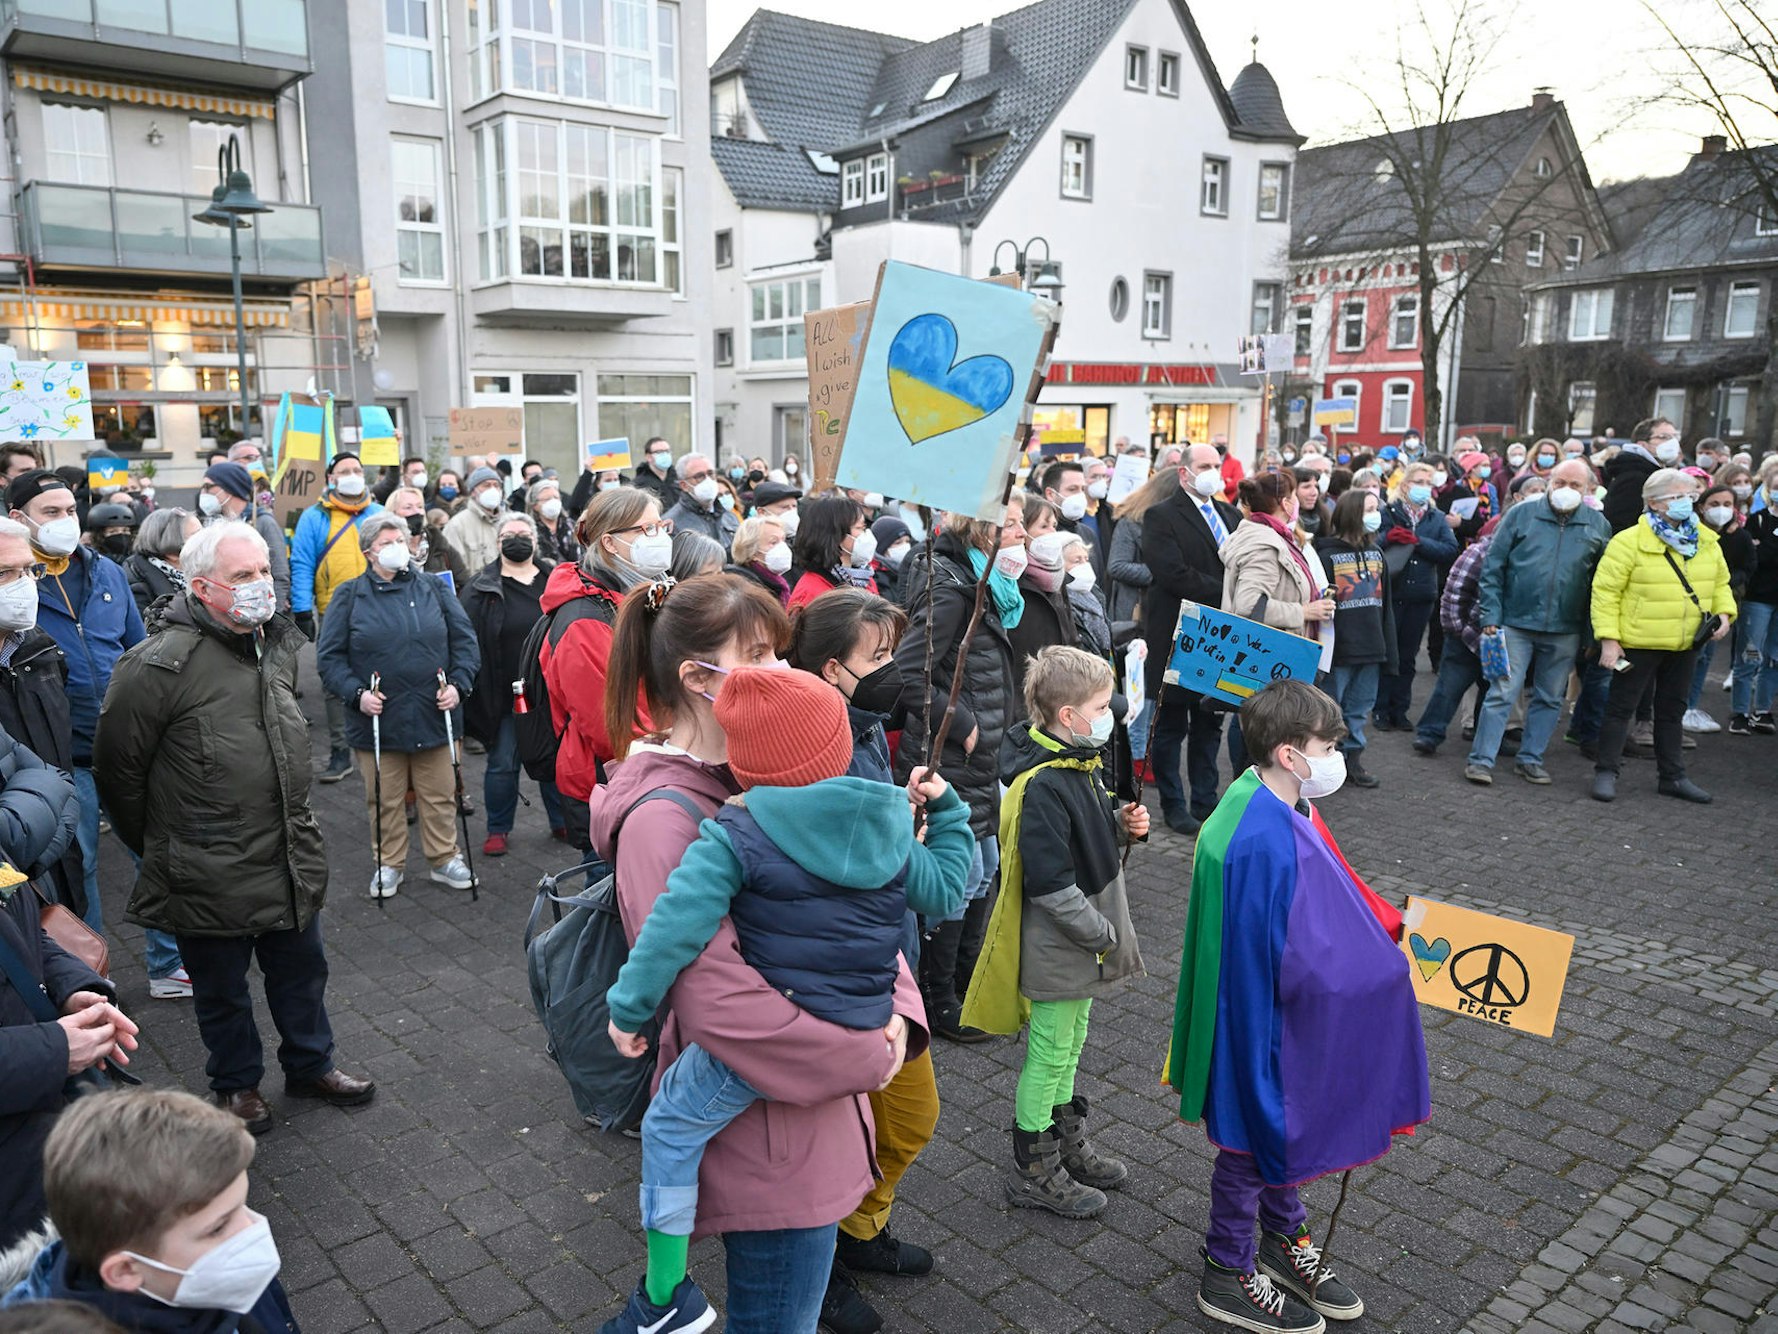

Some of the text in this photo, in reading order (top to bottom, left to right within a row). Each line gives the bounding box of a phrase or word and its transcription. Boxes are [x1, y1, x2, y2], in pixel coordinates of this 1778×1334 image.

[822, 348, 851, 371] wish
[1072, 364, 1141, 384] BAHNHOF
[1147, 366, 1216, 384] APOTHEKE
[821, 445, 832, 457] a
[1198, 614, 1219, 637] No
[1197, 637, 1226, 663] Putin
[1457, 997, 1512, 1025] PEACE
